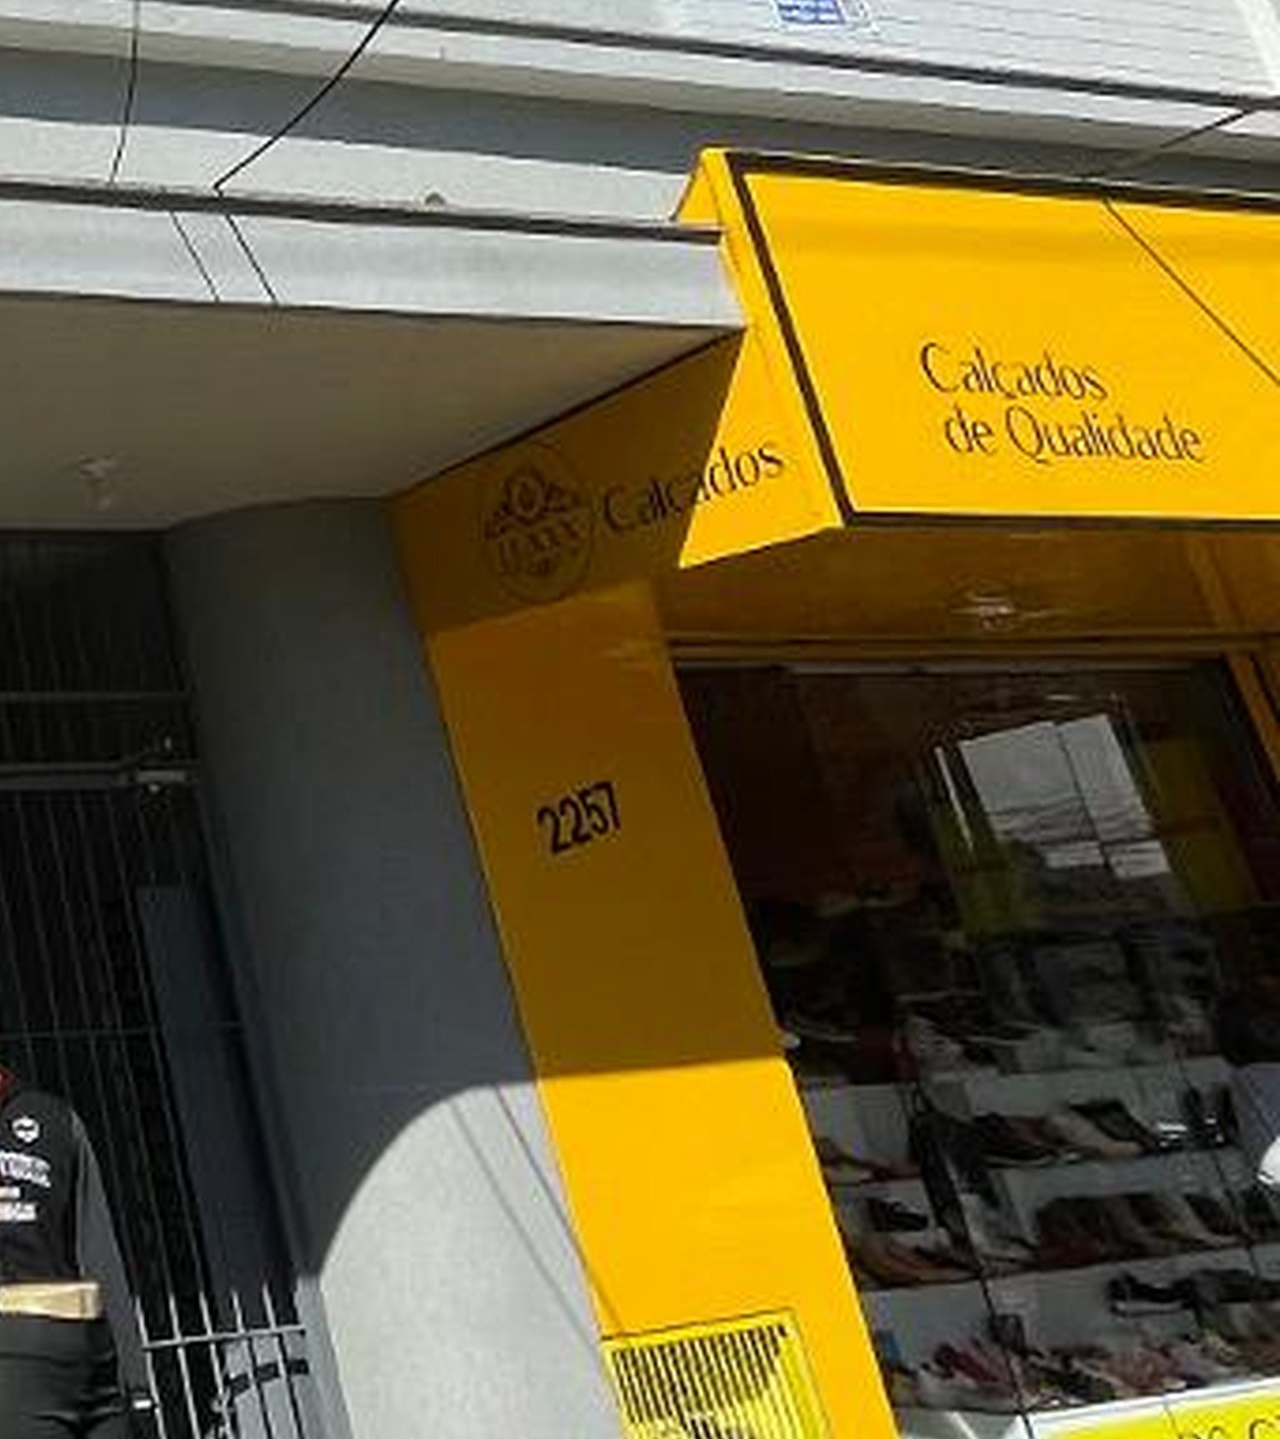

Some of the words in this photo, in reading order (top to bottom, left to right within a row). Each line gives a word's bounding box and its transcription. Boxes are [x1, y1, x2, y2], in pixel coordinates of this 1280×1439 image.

[920, 341, 1108, 401] Calçados
[944, 403, 995, 456] de
[1005, 405, 1206, 464] Qualidade
[537, 780, 623, 856] 2257
